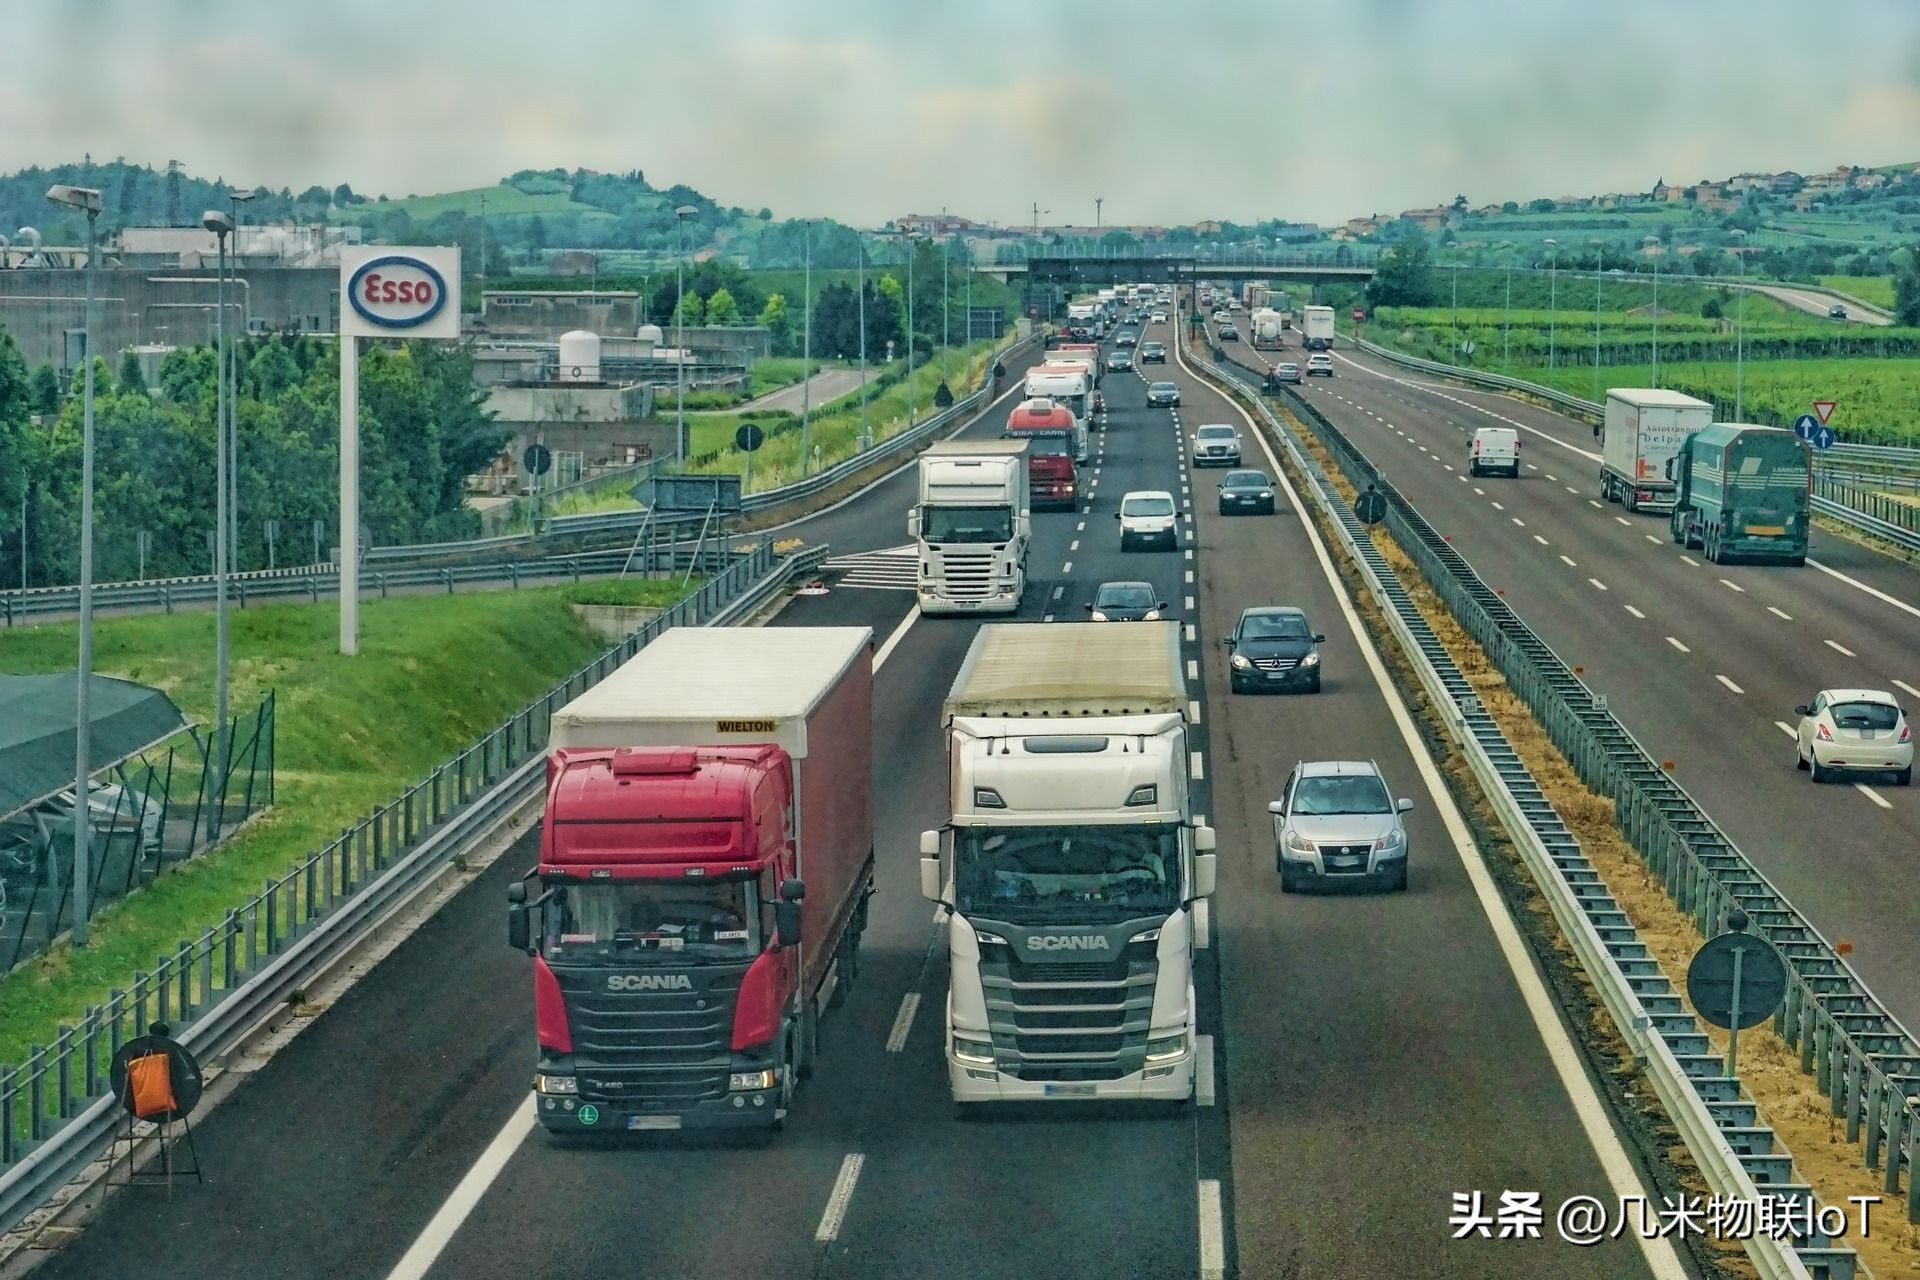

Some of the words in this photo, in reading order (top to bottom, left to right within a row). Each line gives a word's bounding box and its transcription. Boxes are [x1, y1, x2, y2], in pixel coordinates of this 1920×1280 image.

[718, 721, 773, 732] WIELTON
[1027, 936, 1110, 950] SCANIA
[607, 975, 692, 990] SCANIA
